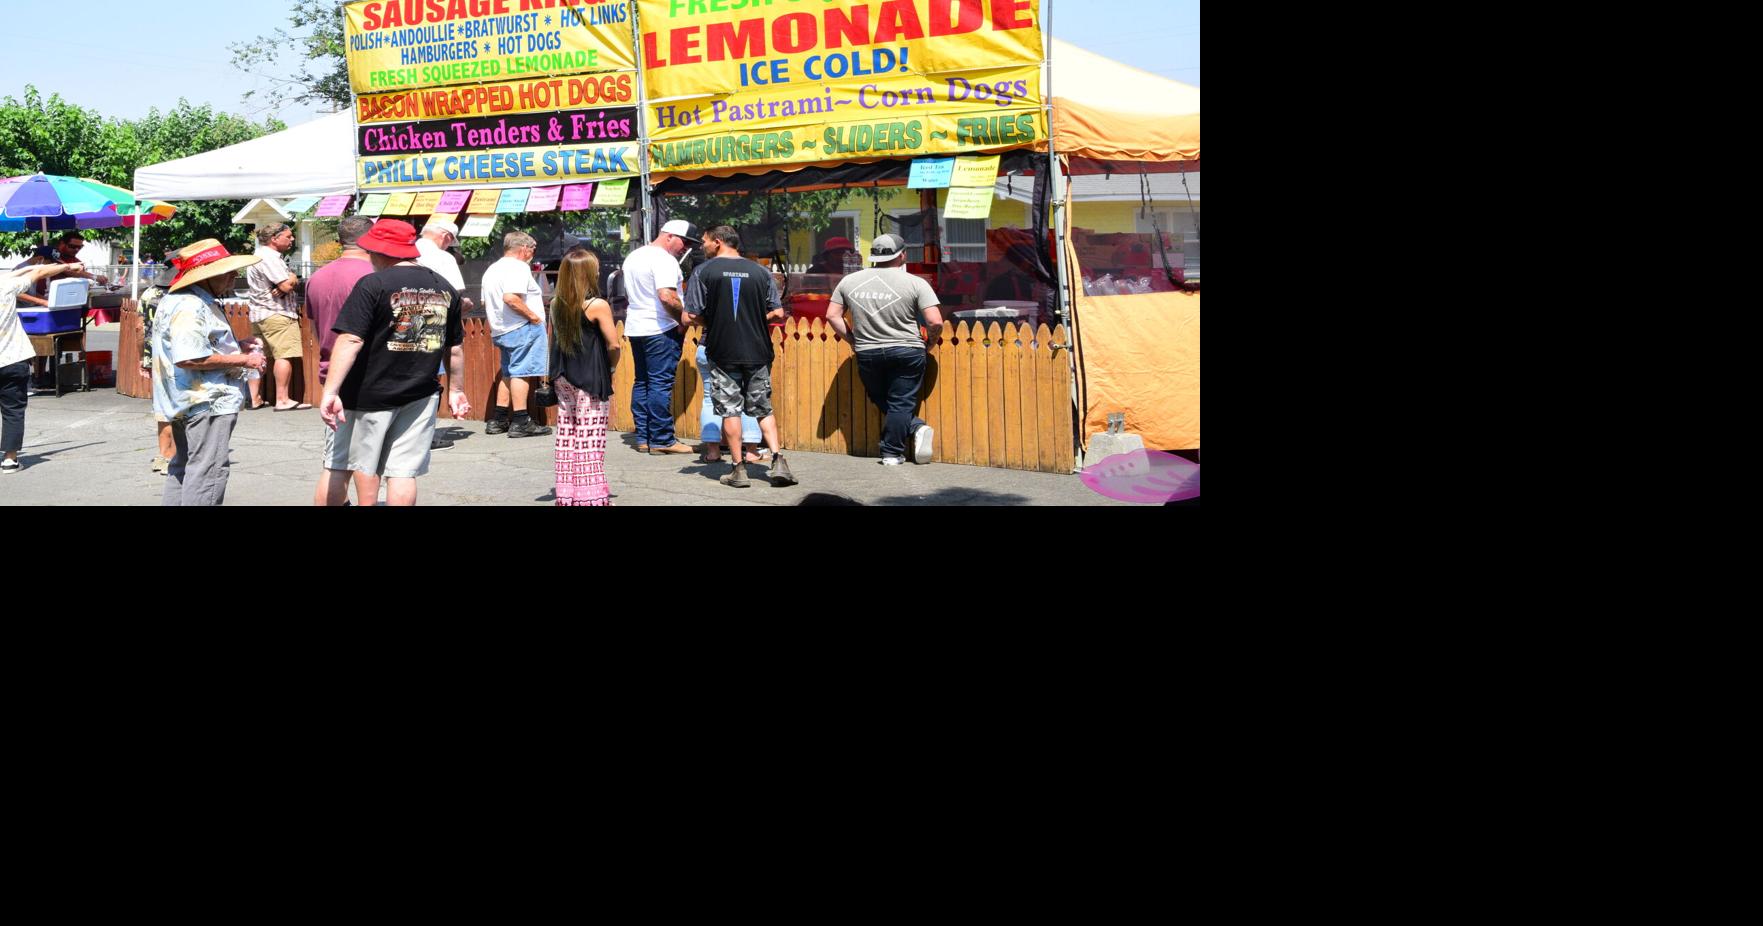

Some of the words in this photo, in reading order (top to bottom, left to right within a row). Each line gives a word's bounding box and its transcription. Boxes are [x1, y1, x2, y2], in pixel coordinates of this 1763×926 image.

[350, 31, 383, 52] POLISH
[391, 23, 455, 48] ANDOULLIE
[465, 13, 538, 39] BRATWURST
[561, 7, 586, 28] HOT
[591, 3, 627, 26] LINKS
[363, 0, 510, 31] SAUSAGE
[669, 0, 774, 18] FRE
[401, 40, 478, 65] HAMBURGERS
[498, 35, 522, 55] HOT
[527, 30, 561, 52] DOGS
[643, 0, 1033, 70] LEMONADE
[370, 67, 418, 88] FRESH
[423, 59, 501, 84] SQUEEZED
[507, 49, 598, 75] LEMONADE
[740, 59, 790, 87] ICE
[803, 47, 909, 81] COLD!
[360, 92, 419, 121] BACON
[421, 85, 514, 116] WRAPPED
[519, 80, 563, 110] HOT
[568, 74, 632, 106] DOGS
[656, 104, 704, 129] Hot
[858, 84, 936, 109] Corn
[945, 77, 1028, 107] Dogs
[364, 126, 447, 152] Chicken
[451, 118, 540, 147] Tenders
[547, 117, 565, 142] &
[570, 111, 630, 140] Fries
[651, 131, 795, 168] HAMBURGERS
[823, 119, 923, 156] SLIDERS
[957, 114, 1036, 147] FRIES
[364, 157, 437, 184] PHILLY
[444, 152, 536, 180] CHEESE
[542, 146, 630, 176] STEAK
[854, 291, 892, 300] VOLCOM
